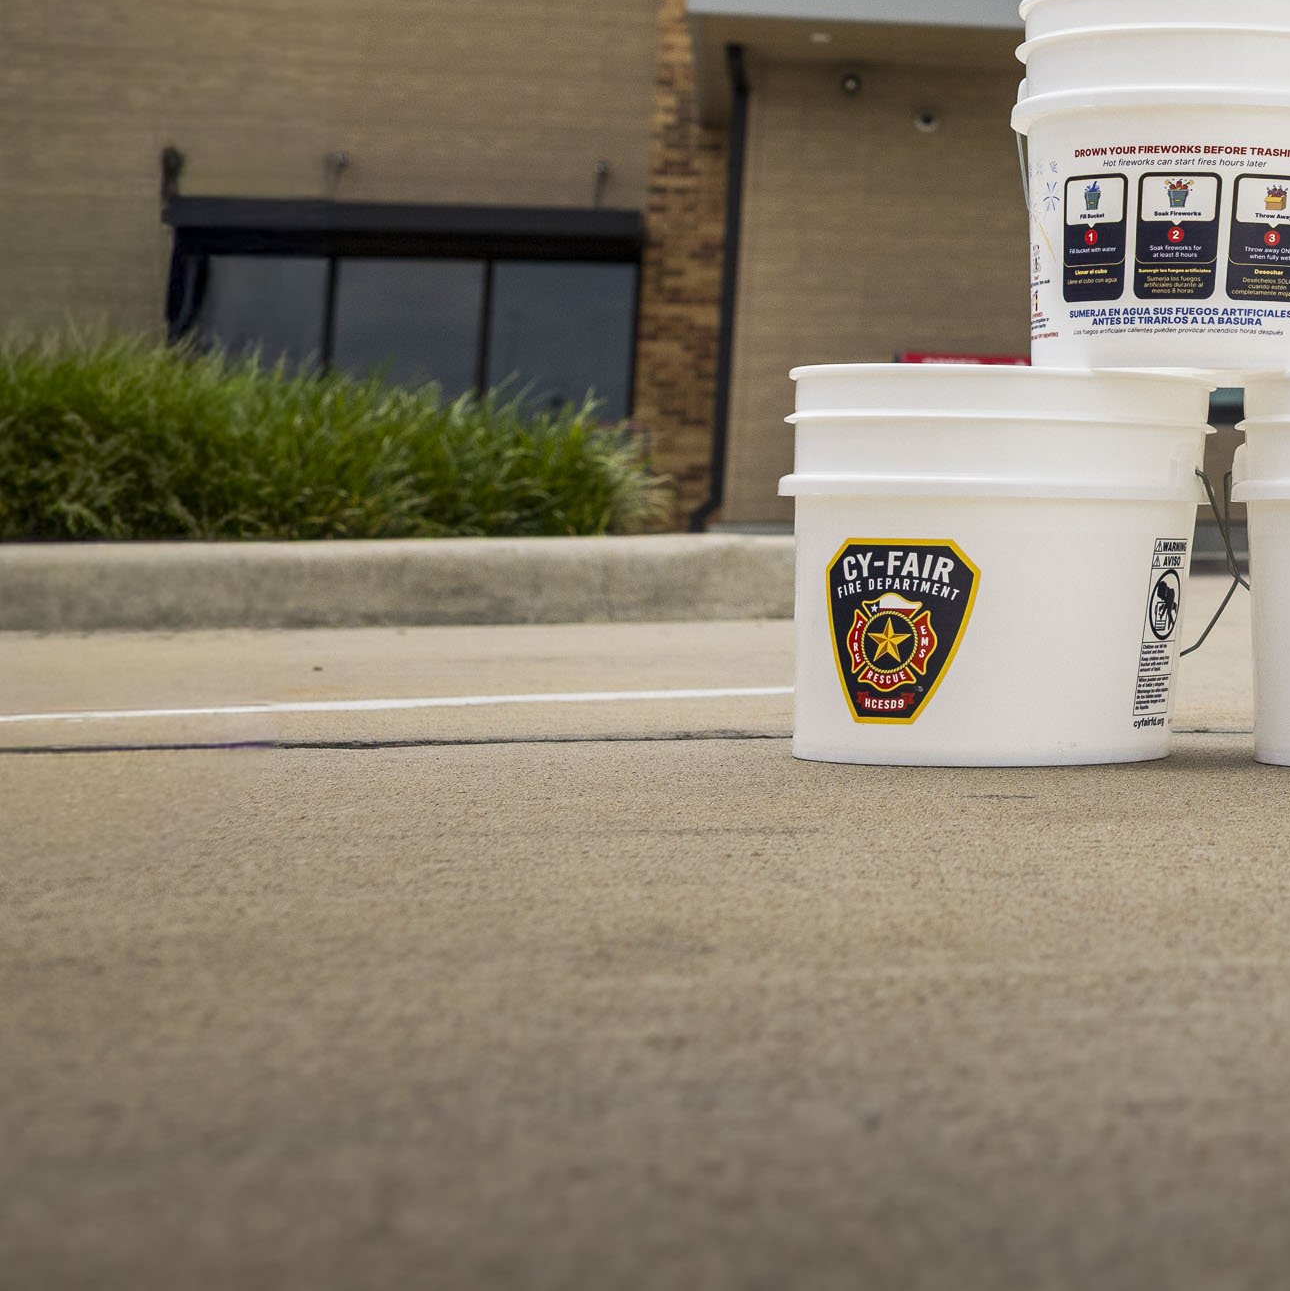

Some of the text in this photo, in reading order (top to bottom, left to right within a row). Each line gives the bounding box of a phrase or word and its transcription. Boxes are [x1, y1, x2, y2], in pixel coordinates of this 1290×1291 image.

[1075, 147, 1107, 157] DROWN
[1109, 146, 1136, 155] YOUR
[1138, 145, 1201, 154] FIREWORKS
[1204, 146, 1247, 155] BEFORE
[1089, 233, 1093, 241] 1
[1173, 230, 1179, 239] 2
[1269, 234, 1275, 242] 3
[1070, 309, 1106, 318] SUMERJA
[1109, 308, 1120, 316] EN
[1153, 307, 1173, 315] SUS
[1176, 307, 1219, 315] FUEGOS
[1092, 317, 1121, 325] ANTES
[1138, 316, 1188, 324] TIRARLOS
[1218, 317, 1262, 326] BASURA
[1163, 541, 1187, 552] WARNING
[1163, 556, 1181, 566] AVISO
[843, 551, 955, 584] CY-FAIR
[837, 578, 960, 601] FIRE DEPARTMENT
[853, 620, 863, 663] FIRE
[918, 625, 929, 659] EMS
[867, 671, 906, 684] RESCUE
[865, 697, 904, 709] HCESD9
